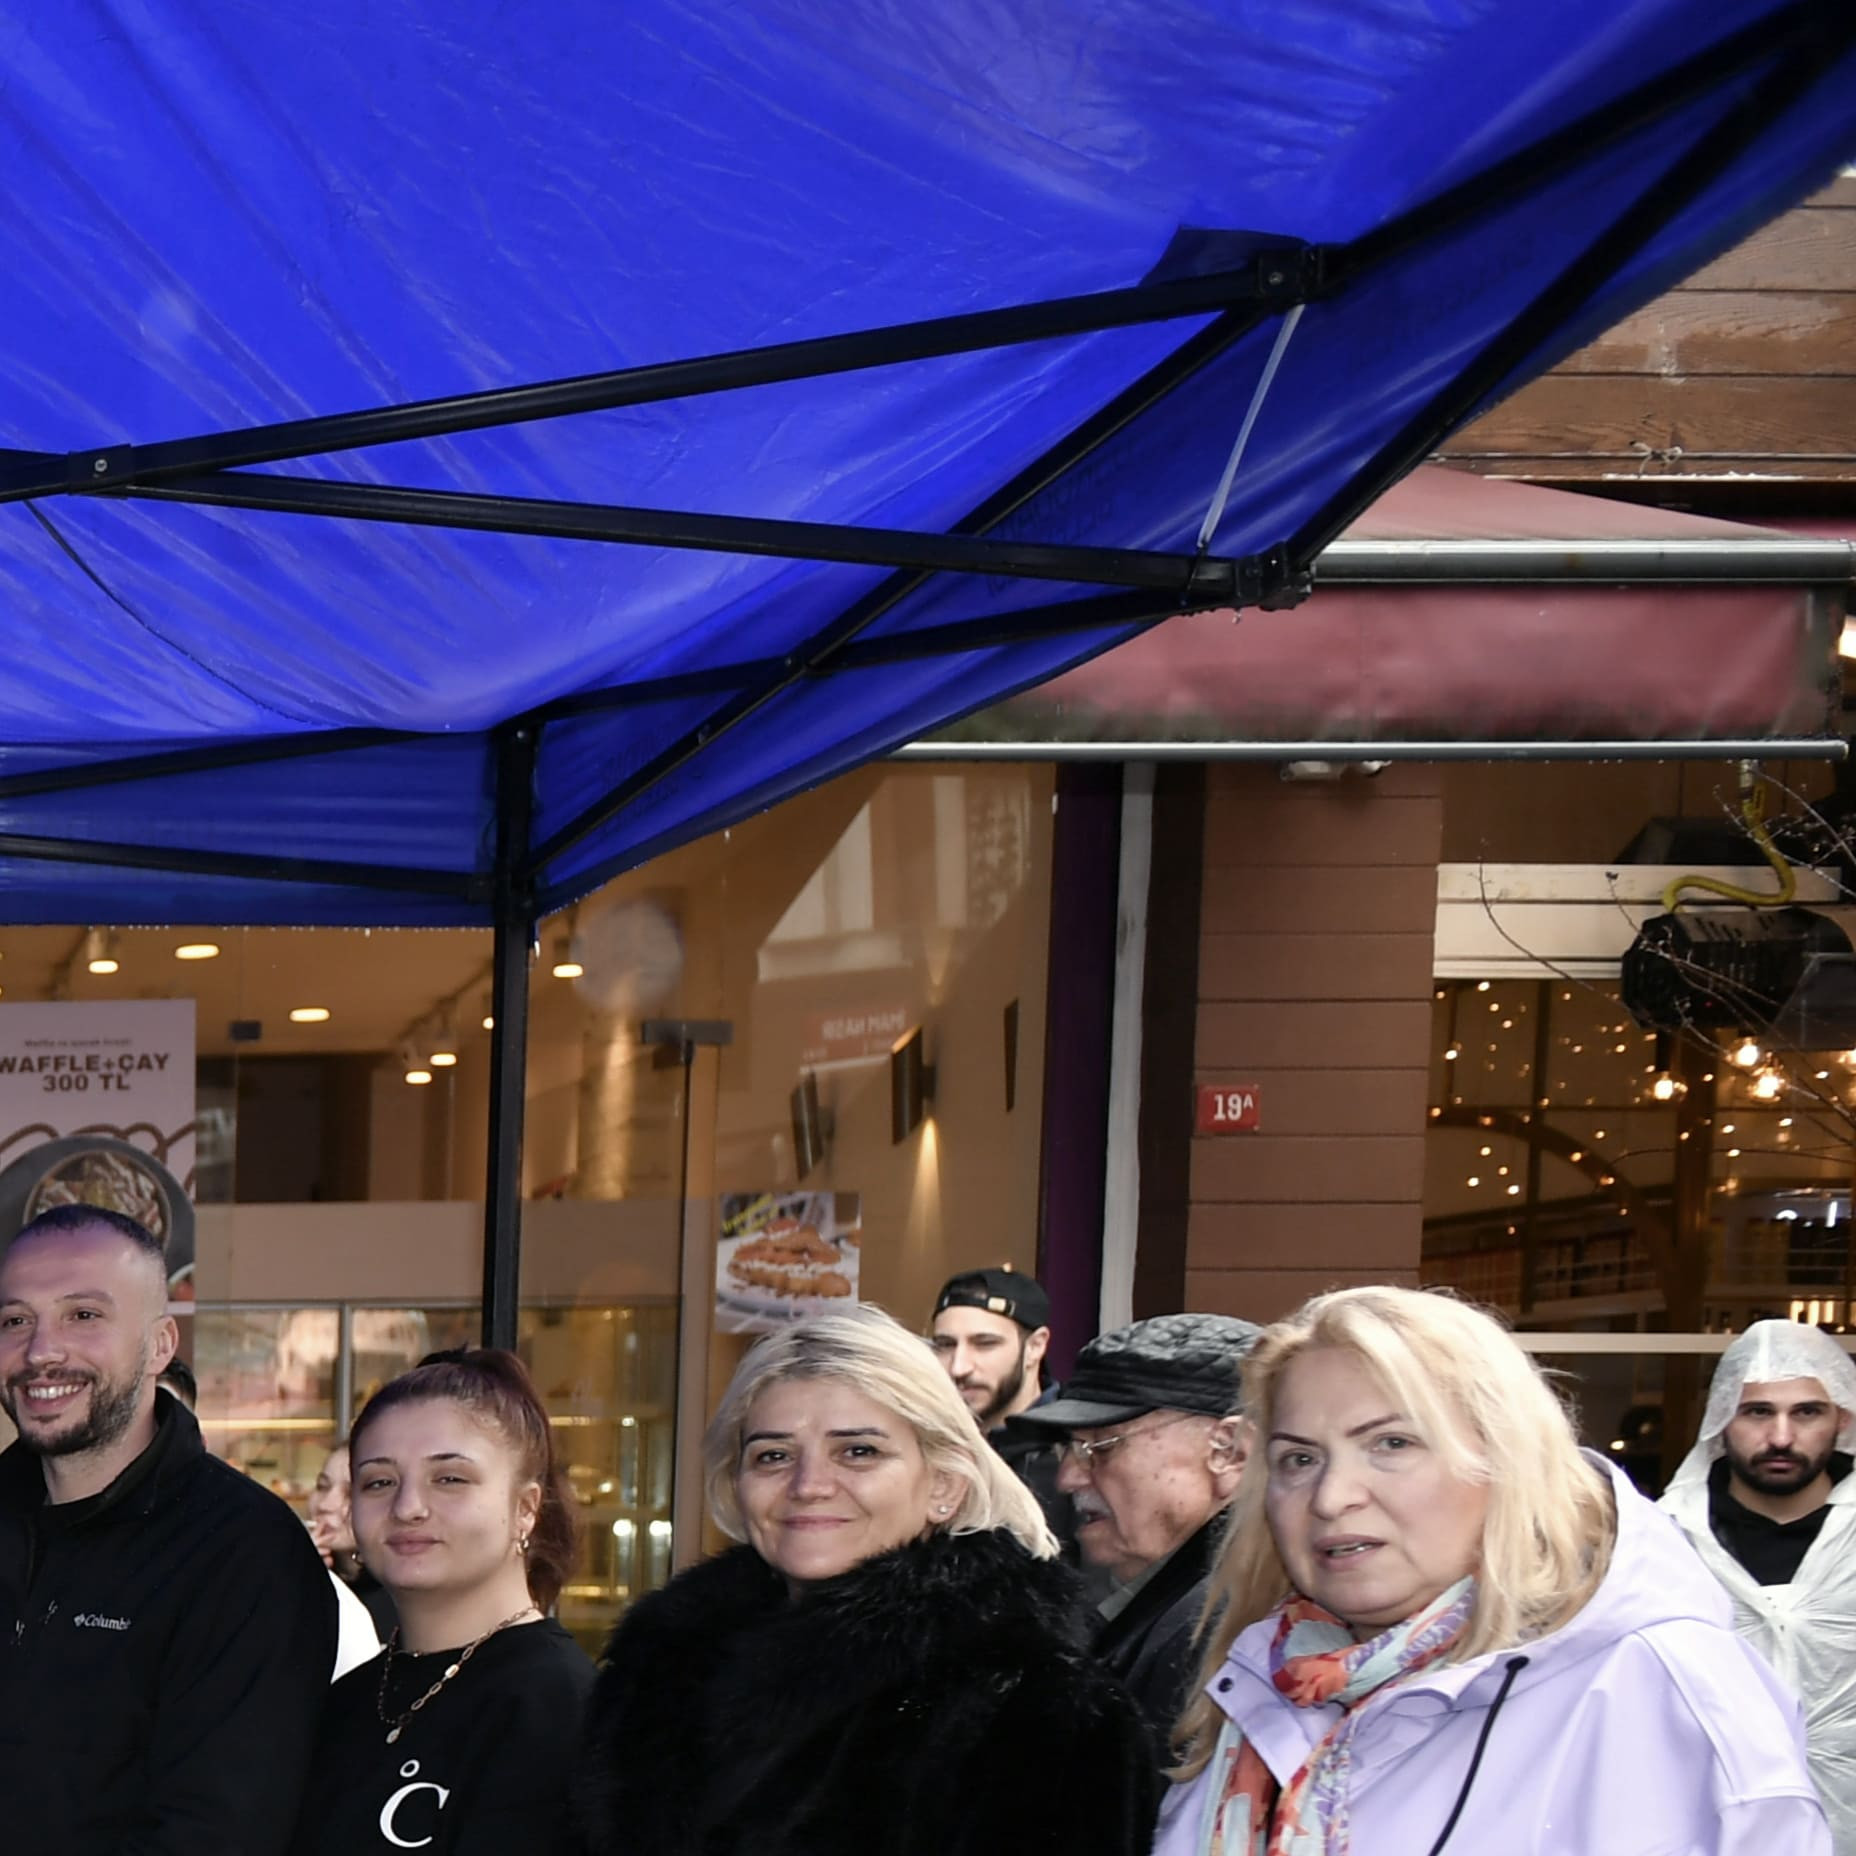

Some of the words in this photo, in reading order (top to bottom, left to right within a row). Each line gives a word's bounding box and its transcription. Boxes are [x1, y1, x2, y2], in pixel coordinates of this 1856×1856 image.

[42, 1074, 89, 1092] 300
[99, 1074, 131, 1091] TL
[1213, 1093, 1254, 1121] 19A
